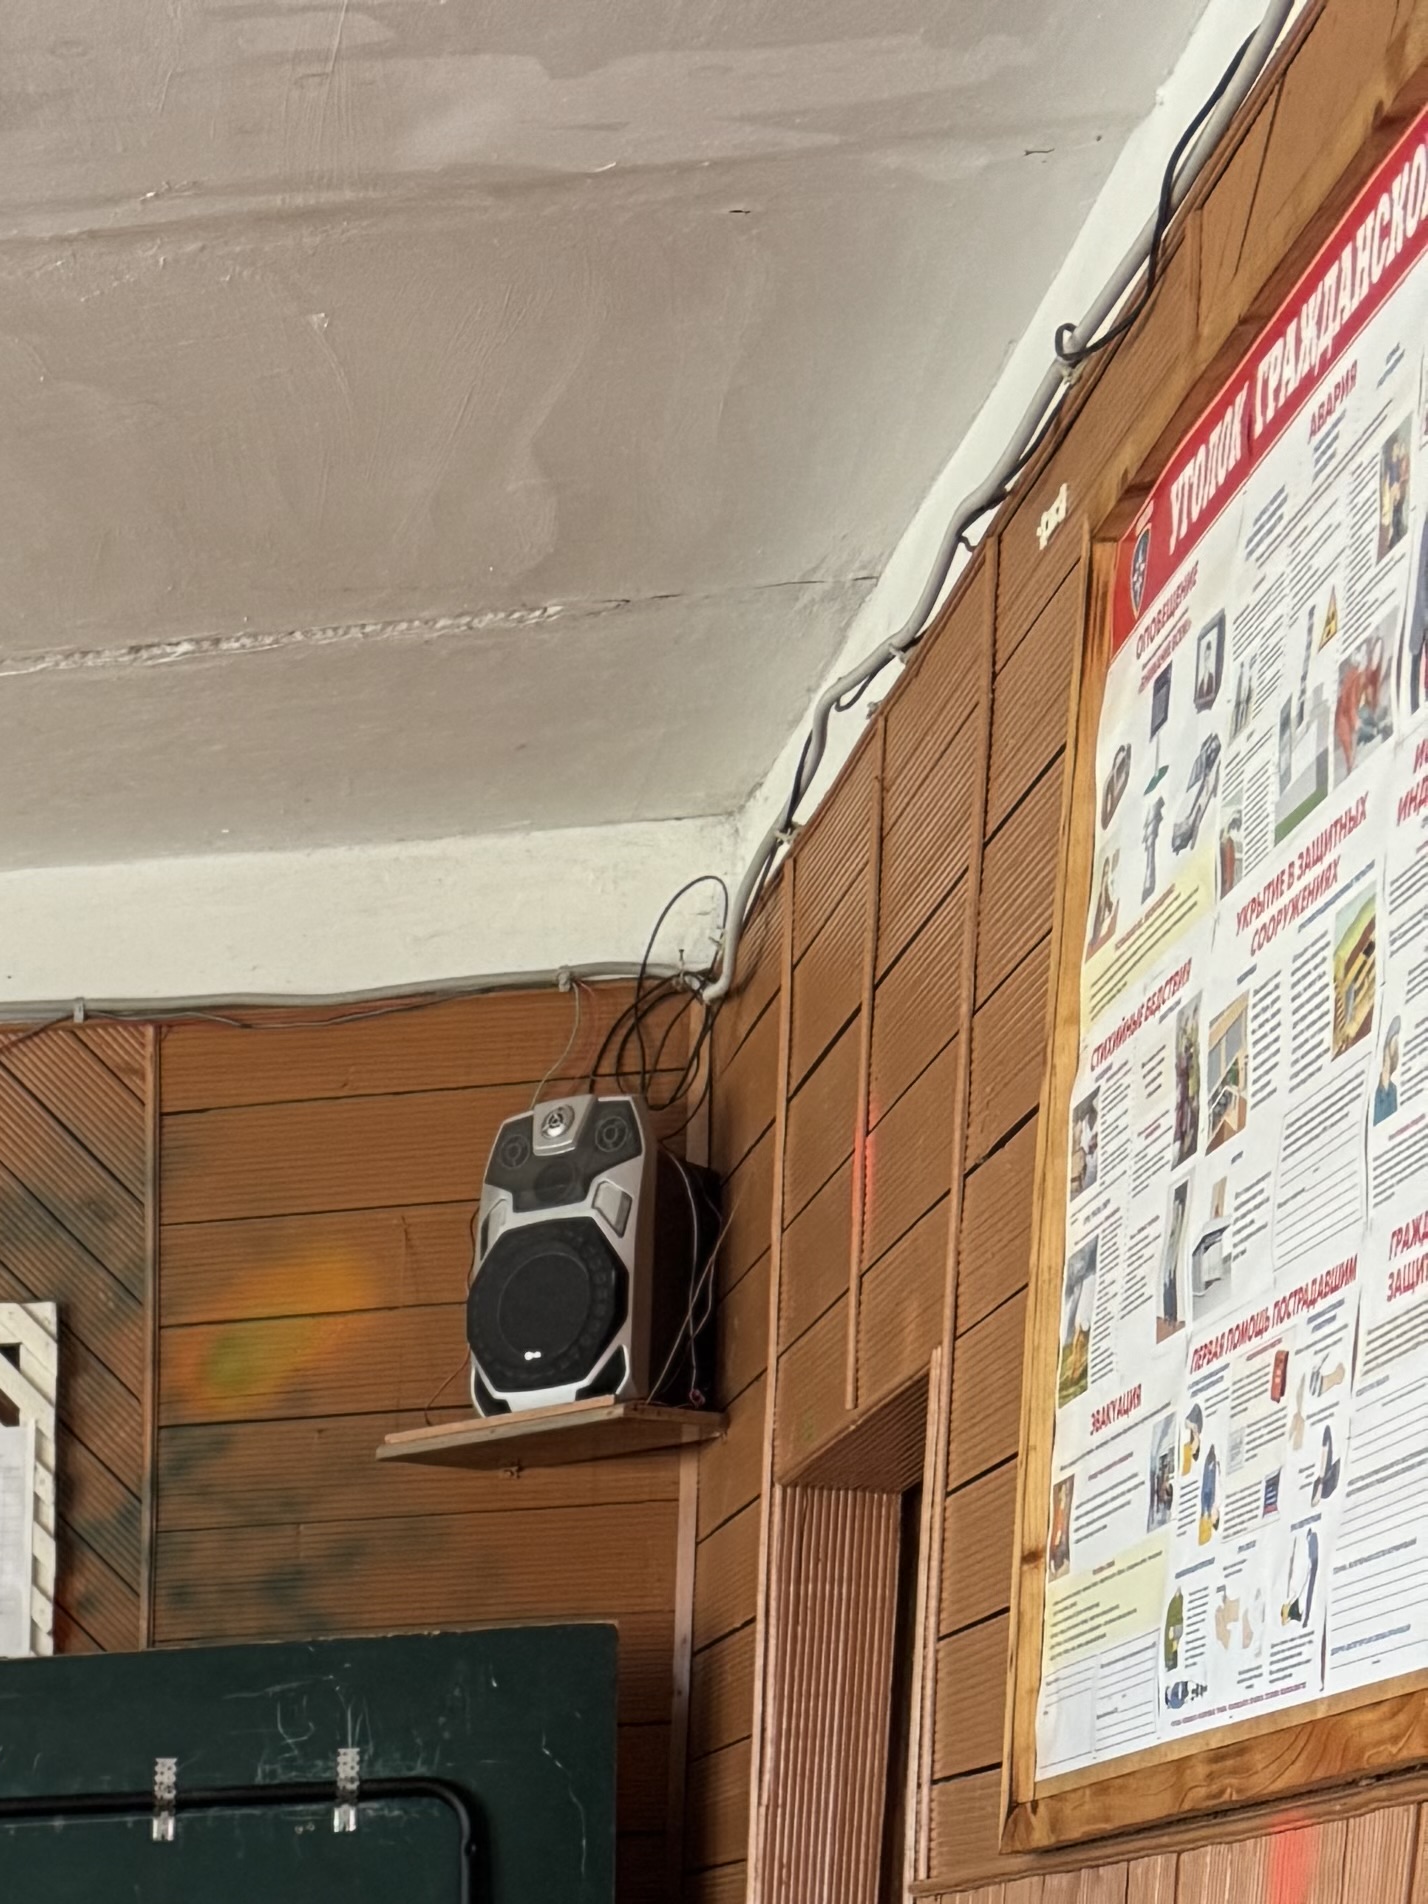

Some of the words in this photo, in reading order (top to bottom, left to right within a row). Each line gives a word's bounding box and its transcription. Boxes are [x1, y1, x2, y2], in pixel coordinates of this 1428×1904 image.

[1169, 380, 1249, 556] УГОЛОК
[1253, 133, 1428, 440] ГРАЖДАНСКО
[1307, 359, 1357, 446] АВАРИЯ
[1396, 775, 1428, 828] ИНД
[1236, 871, 1285, 937] УКРЫТИЕ
[1287, 864, 1295, 889] В
[1296, 791, 1369, 881] ЗАЩИТНЫХ
[1251, 855, 1341, 957] СООРУЖЕНИЯХ
[1144, 957, 1192, 1022] БЕДСТВИЯ
[1190, 1330, 1227, 1374] ПЕРВАЯ
[1229, 1305, 1270, 1352] ПОМОЩЬ
[1271, 1254, 1358, 1326] ПОСТРАДАВШИМ
[1090, 1383, 1142, 1436] ЭВАКУАЦИЯ
